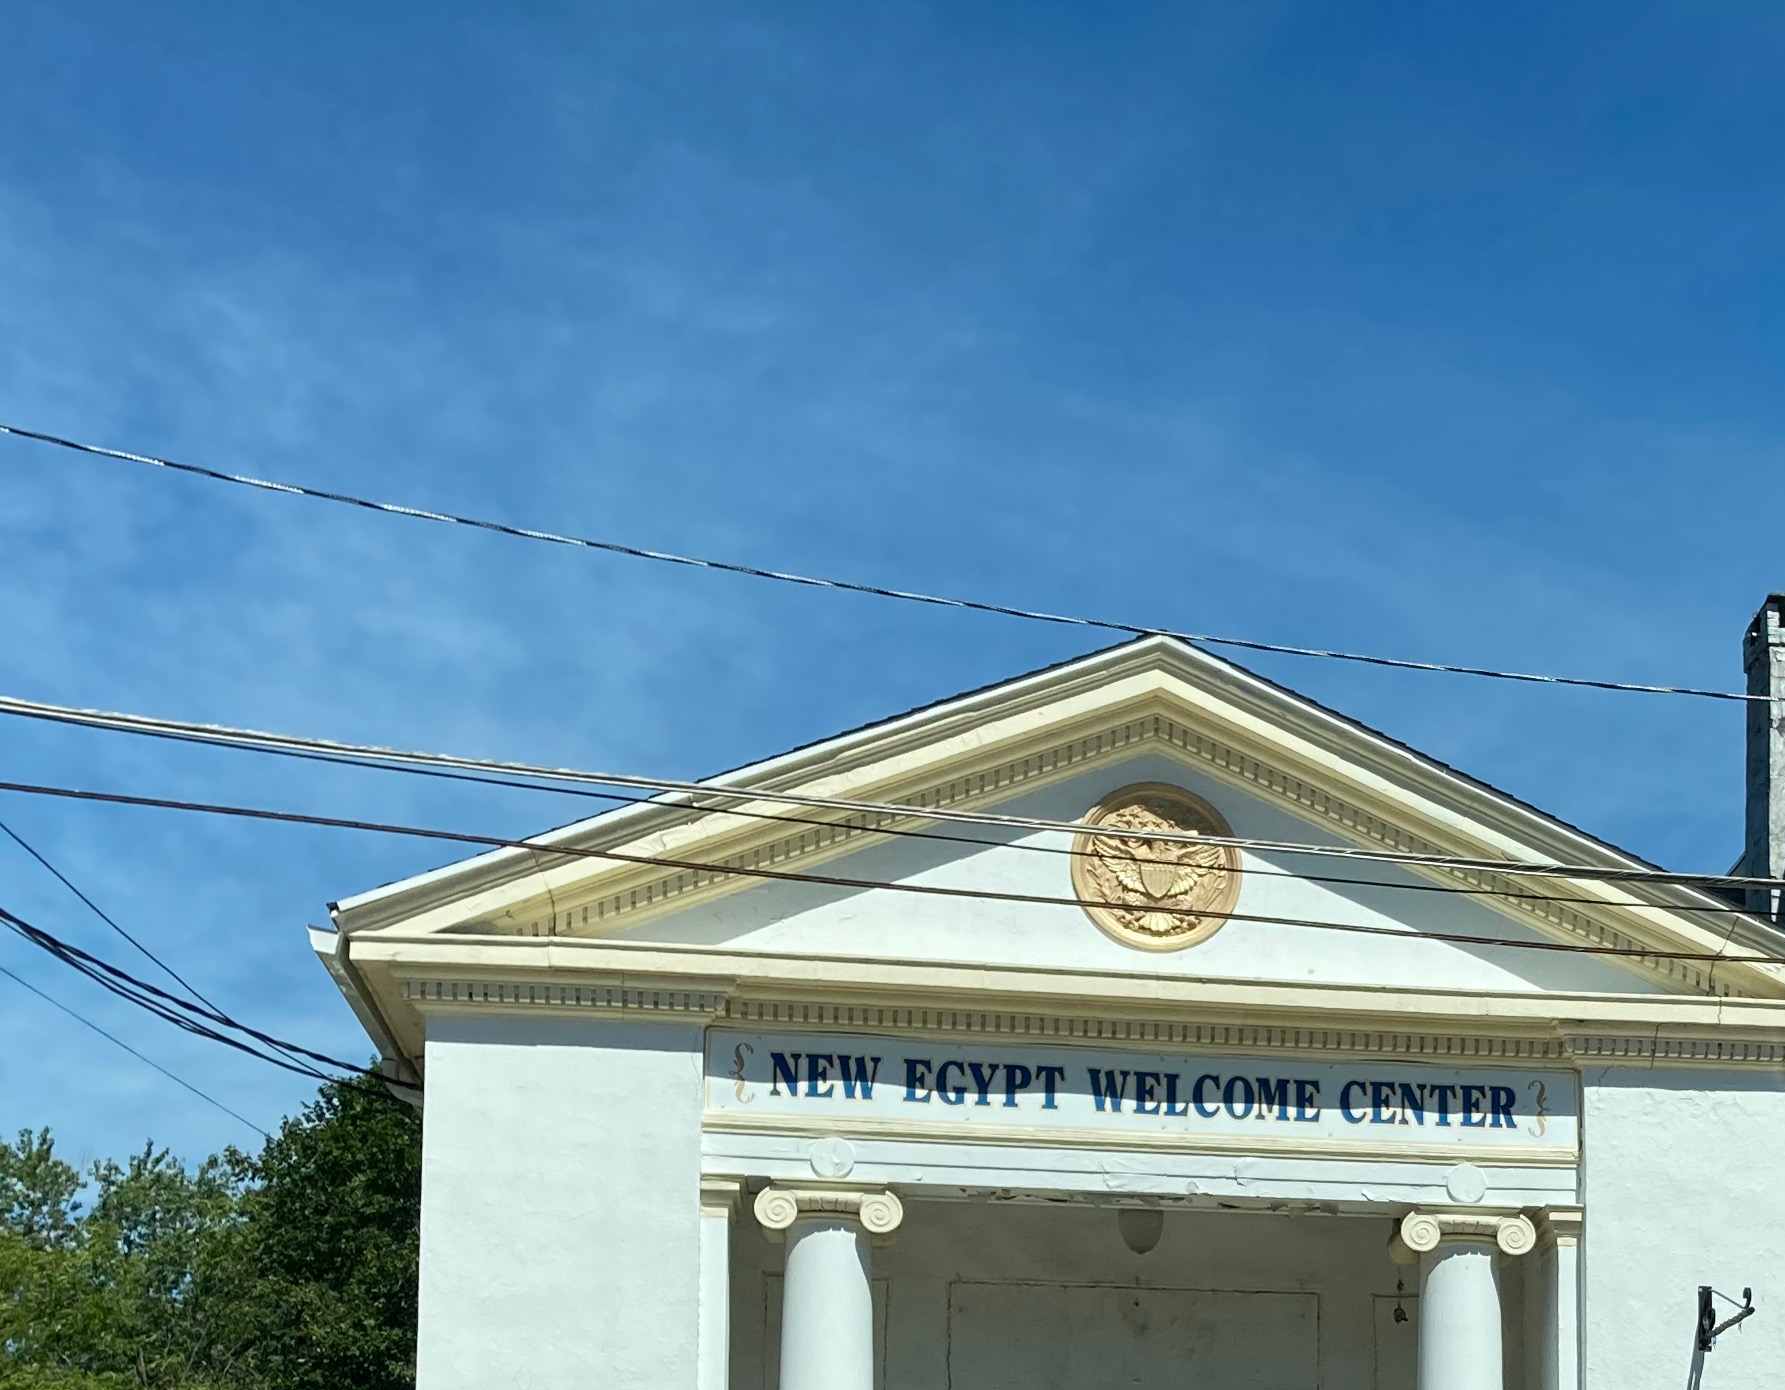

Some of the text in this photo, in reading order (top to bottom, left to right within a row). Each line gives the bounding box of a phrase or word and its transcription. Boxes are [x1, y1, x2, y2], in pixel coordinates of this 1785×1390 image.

[770, 1052, 1518, 1129] NEW EGYPT WELCOME CENTER
